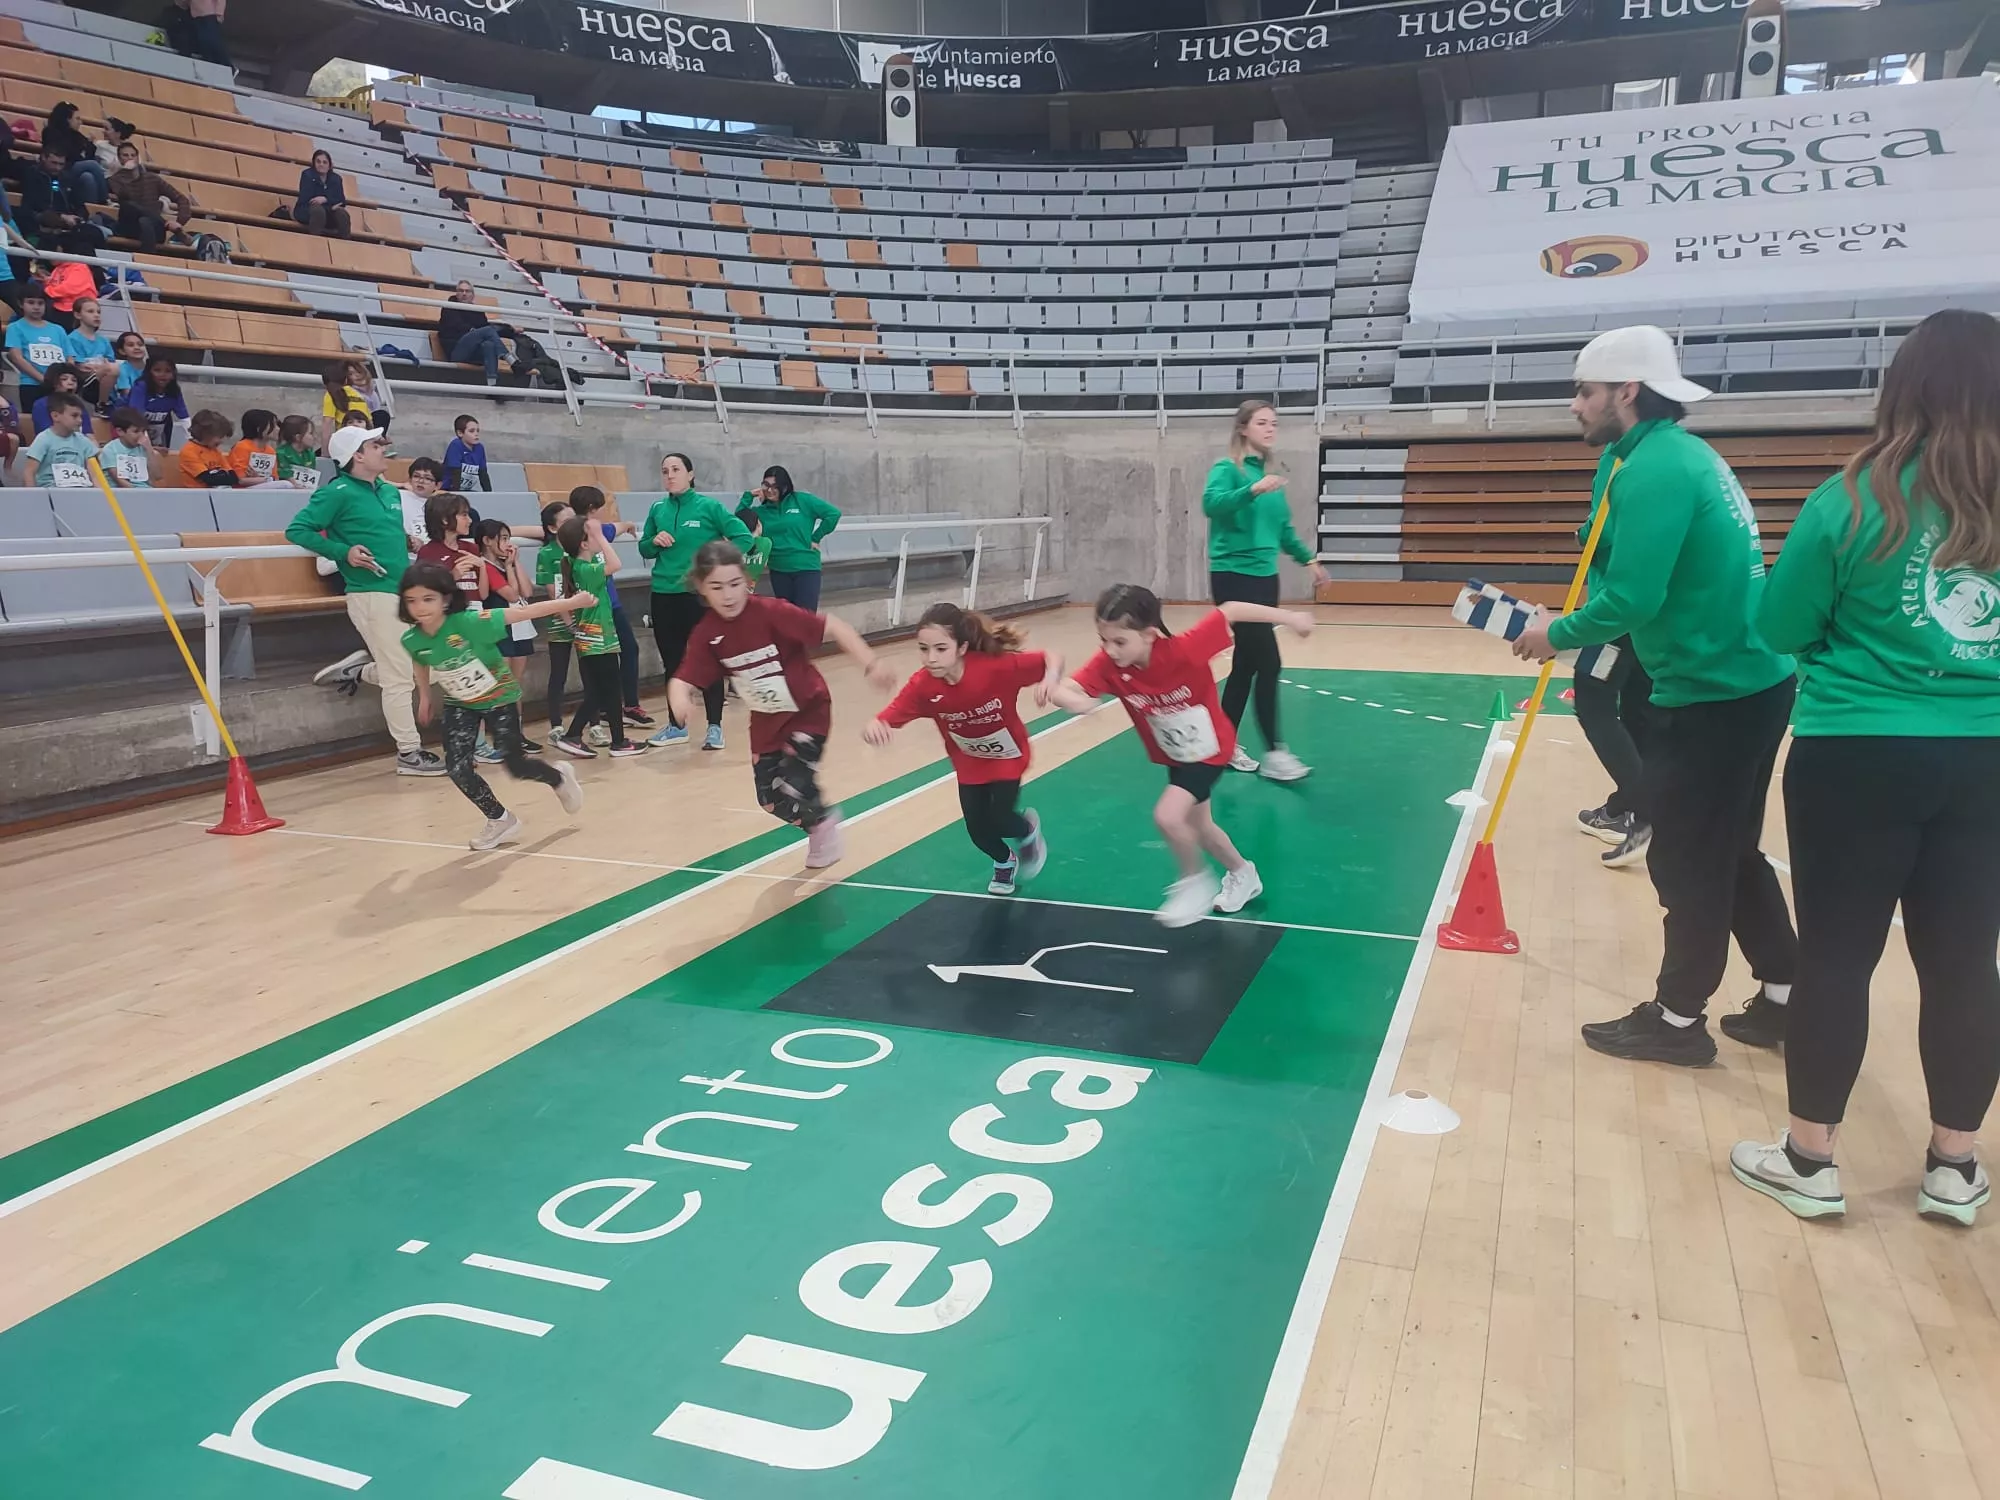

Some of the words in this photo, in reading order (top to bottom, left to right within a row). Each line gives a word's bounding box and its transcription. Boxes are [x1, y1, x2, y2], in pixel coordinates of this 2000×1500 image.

[577, 6, 736, 53] Huesca
[1397, 0, 1564, 37] Huesca
[609, 45, 636, 63] La
[1177, 24, 1330, 62] Huesca
[1425, 42, 1450, 58] La
[912, 46, 1056, 68] Ayuntamiento
[944, 69, 1021, 88] Huesca
[1207, 66, 1231, 82] La
[1488, 128, 1958, 192] Huesca
[1544, 186, 1625, 213] La
[1675, 222, 1907, 248] DIPUTACIÓN
[1675, 237, 1909, 262] HUESCA
[253, 459, 271, 470] 359
[975, 698, 1003, 716] RUBIO
[500, 1056, 1154, 1500] uesca
